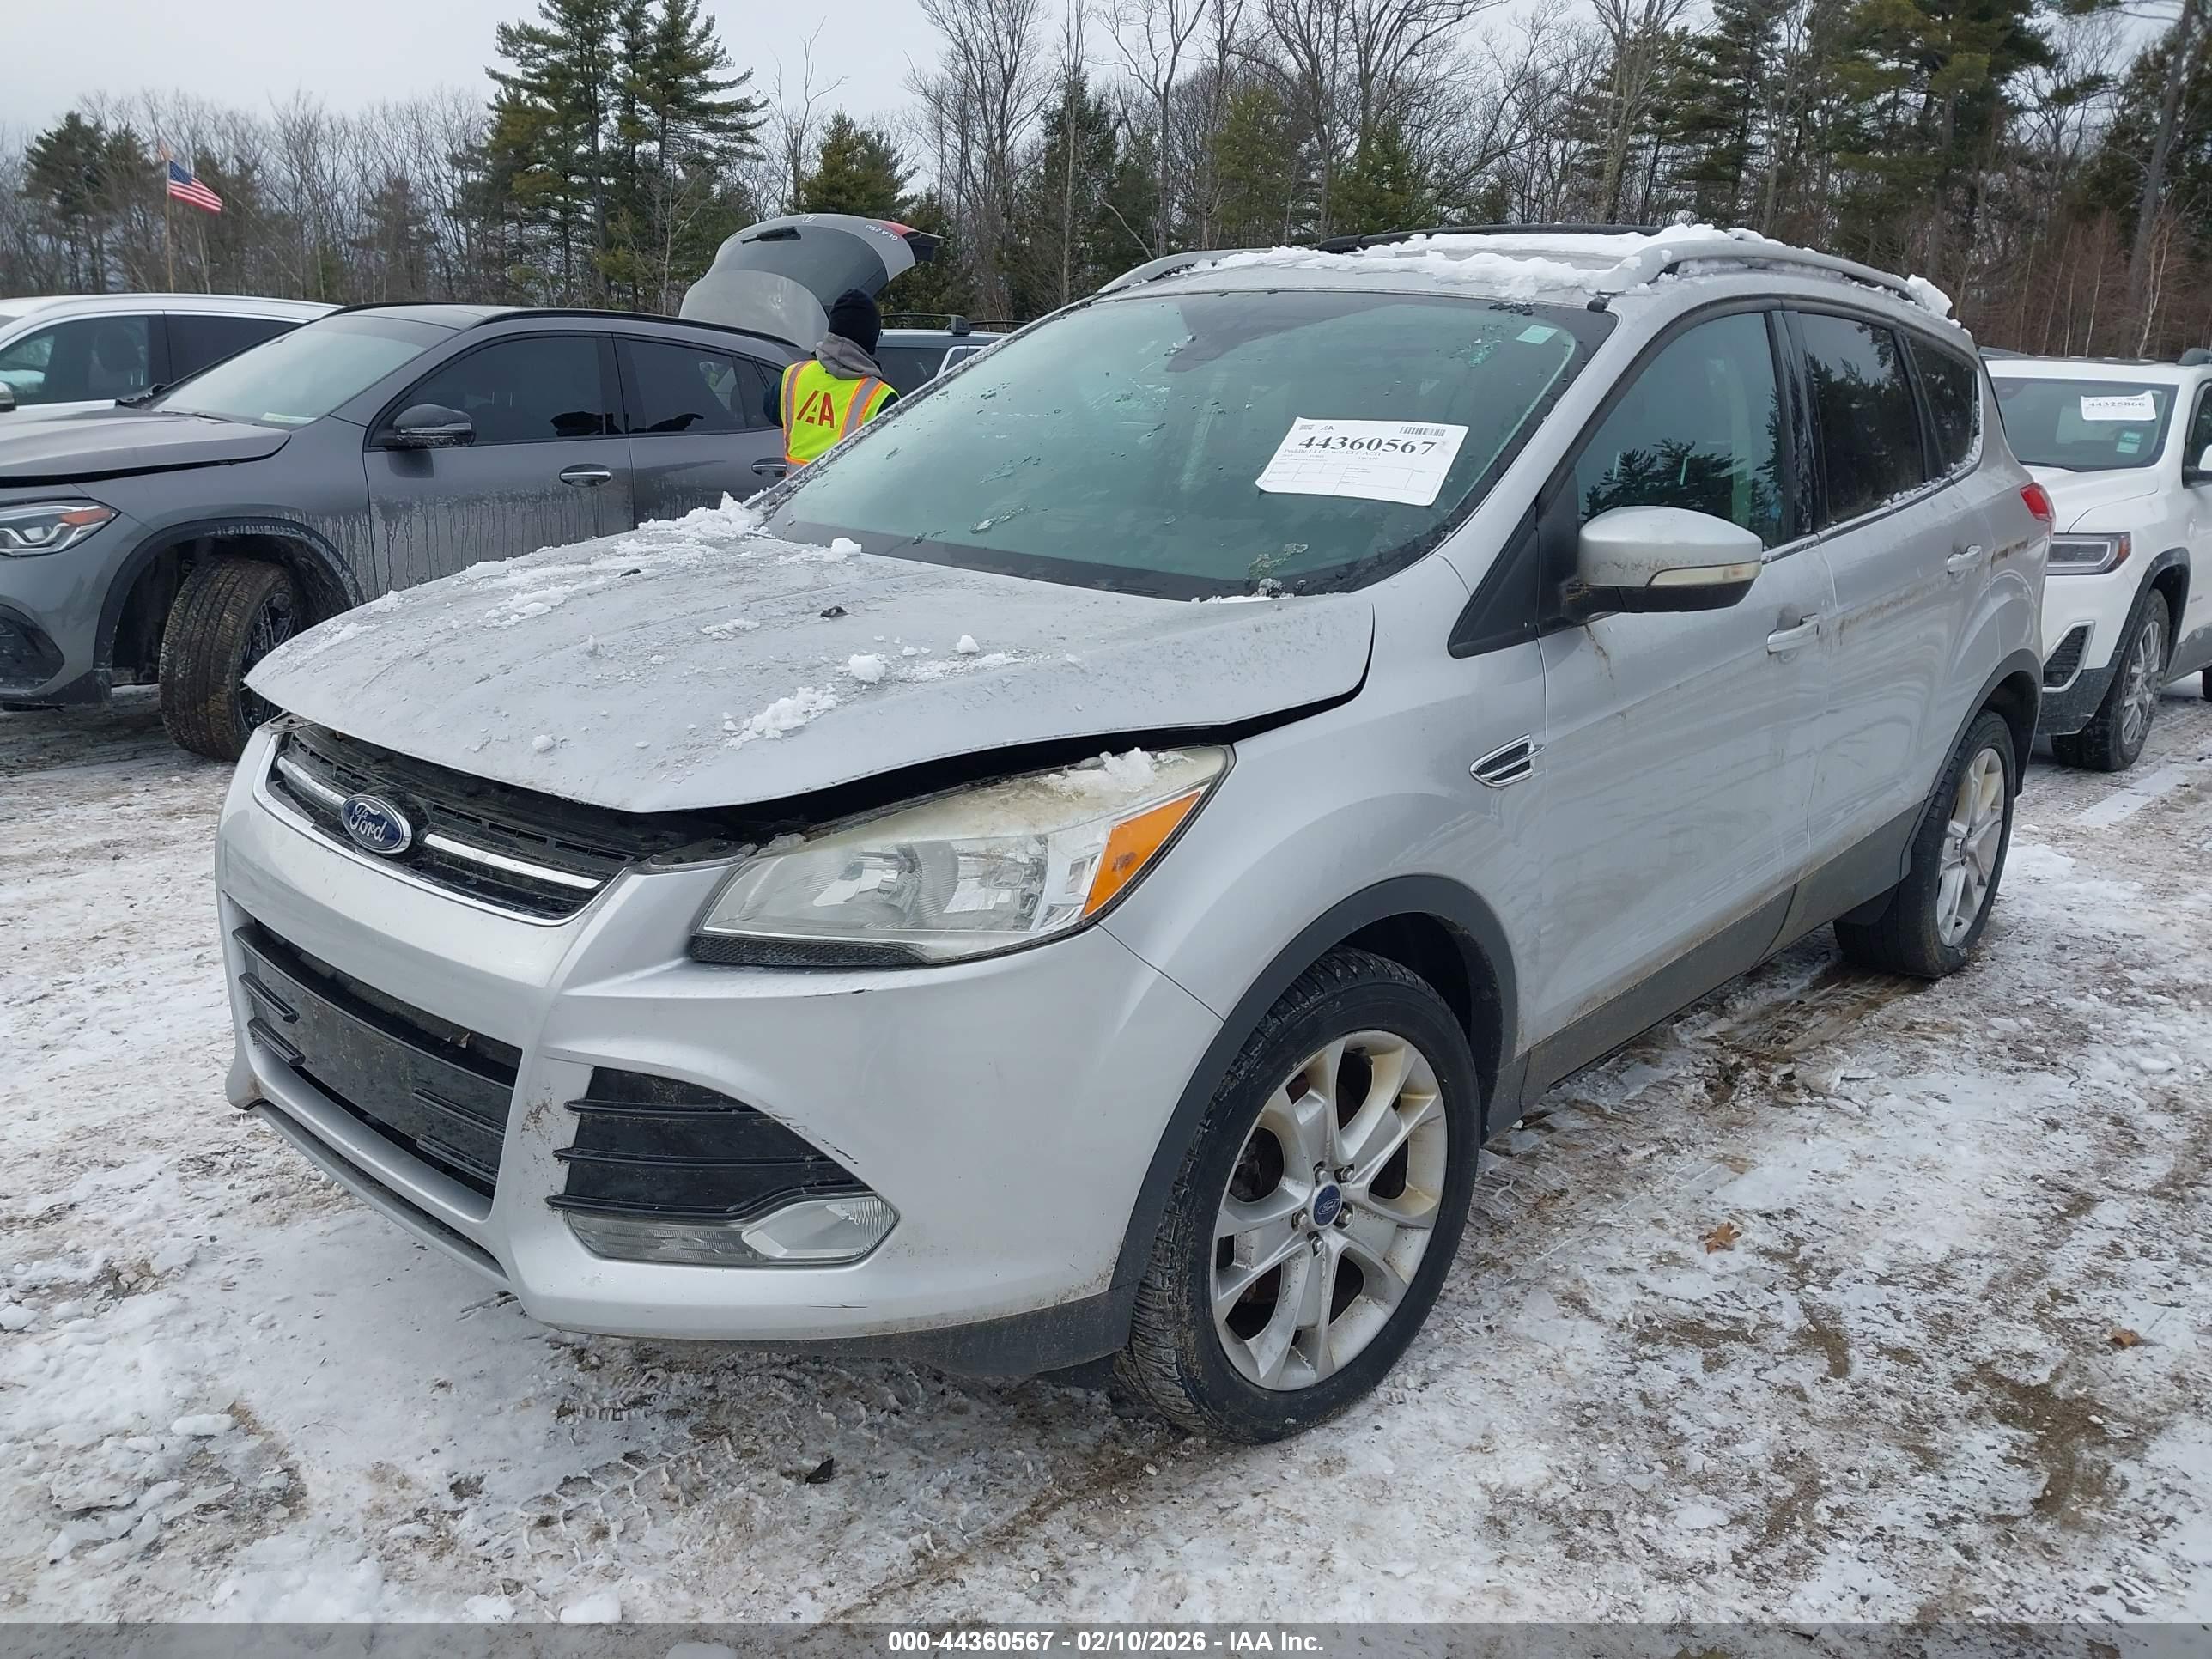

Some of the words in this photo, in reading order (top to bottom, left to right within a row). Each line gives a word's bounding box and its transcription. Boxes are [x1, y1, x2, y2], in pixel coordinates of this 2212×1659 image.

[882, 230, 898, 241] GLA
[1298, 435, 1437, 455] 44360567
[349, 802, 388, 842] Ford
